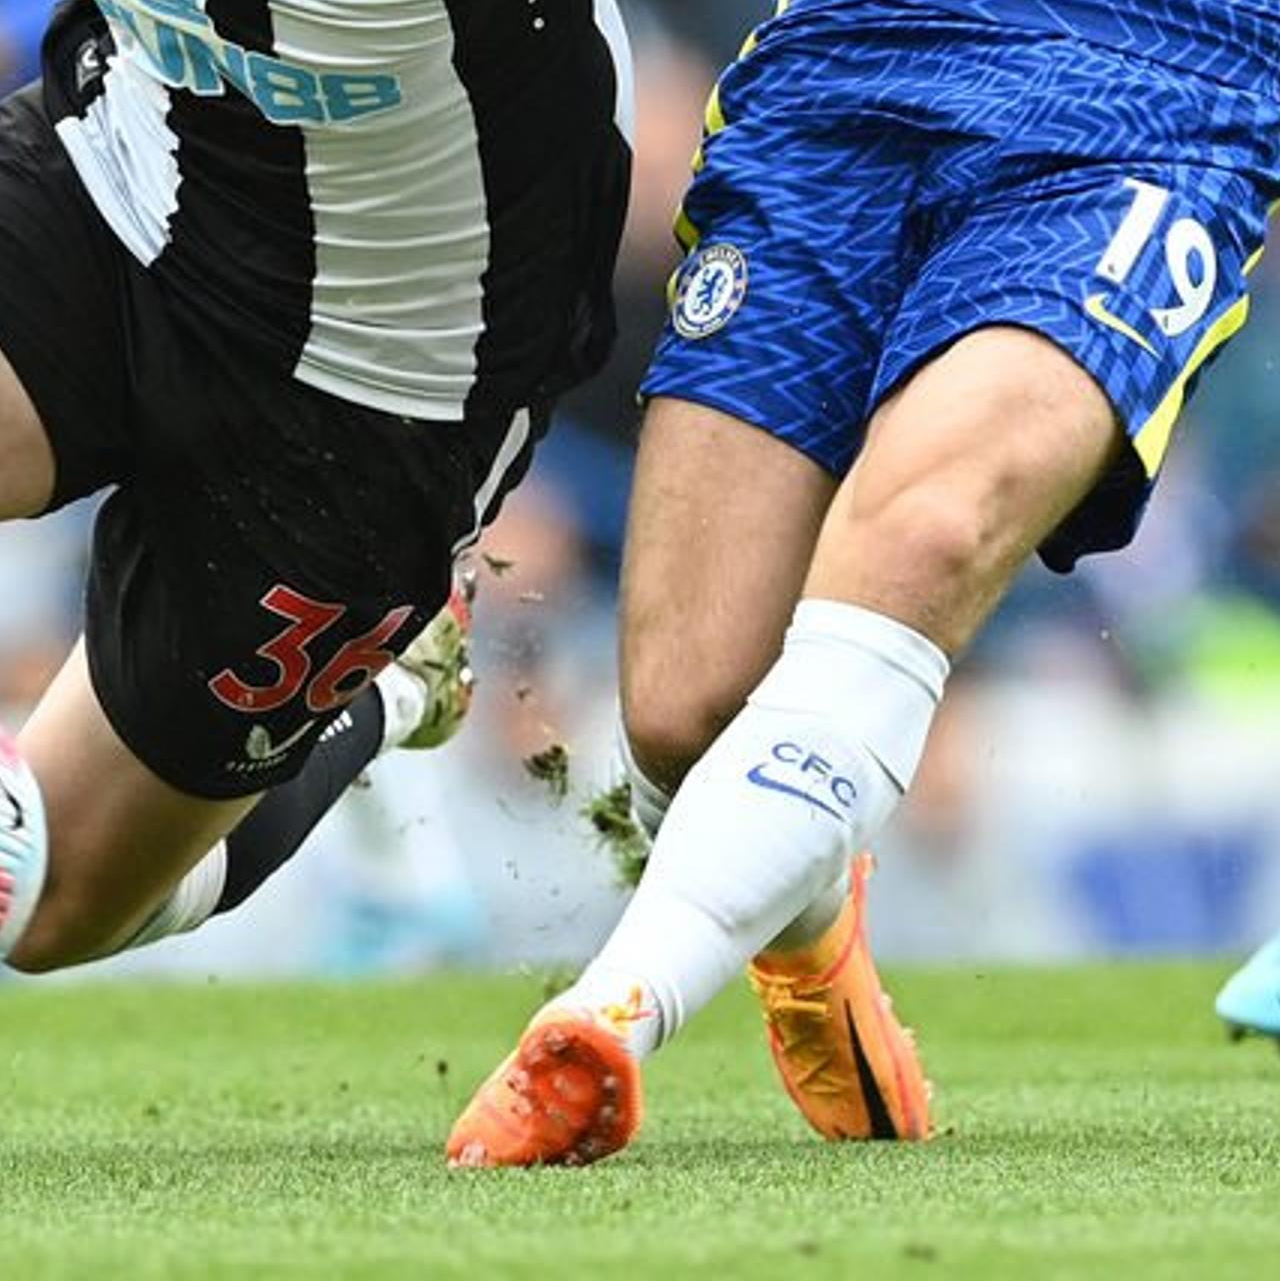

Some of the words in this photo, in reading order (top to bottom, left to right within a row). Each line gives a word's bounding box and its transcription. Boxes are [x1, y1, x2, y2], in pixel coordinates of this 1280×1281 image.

[1098, 176, 1217, 337] 19
[207, 583, 415, 714] 36
[771, 742, 857, 808] CFC
